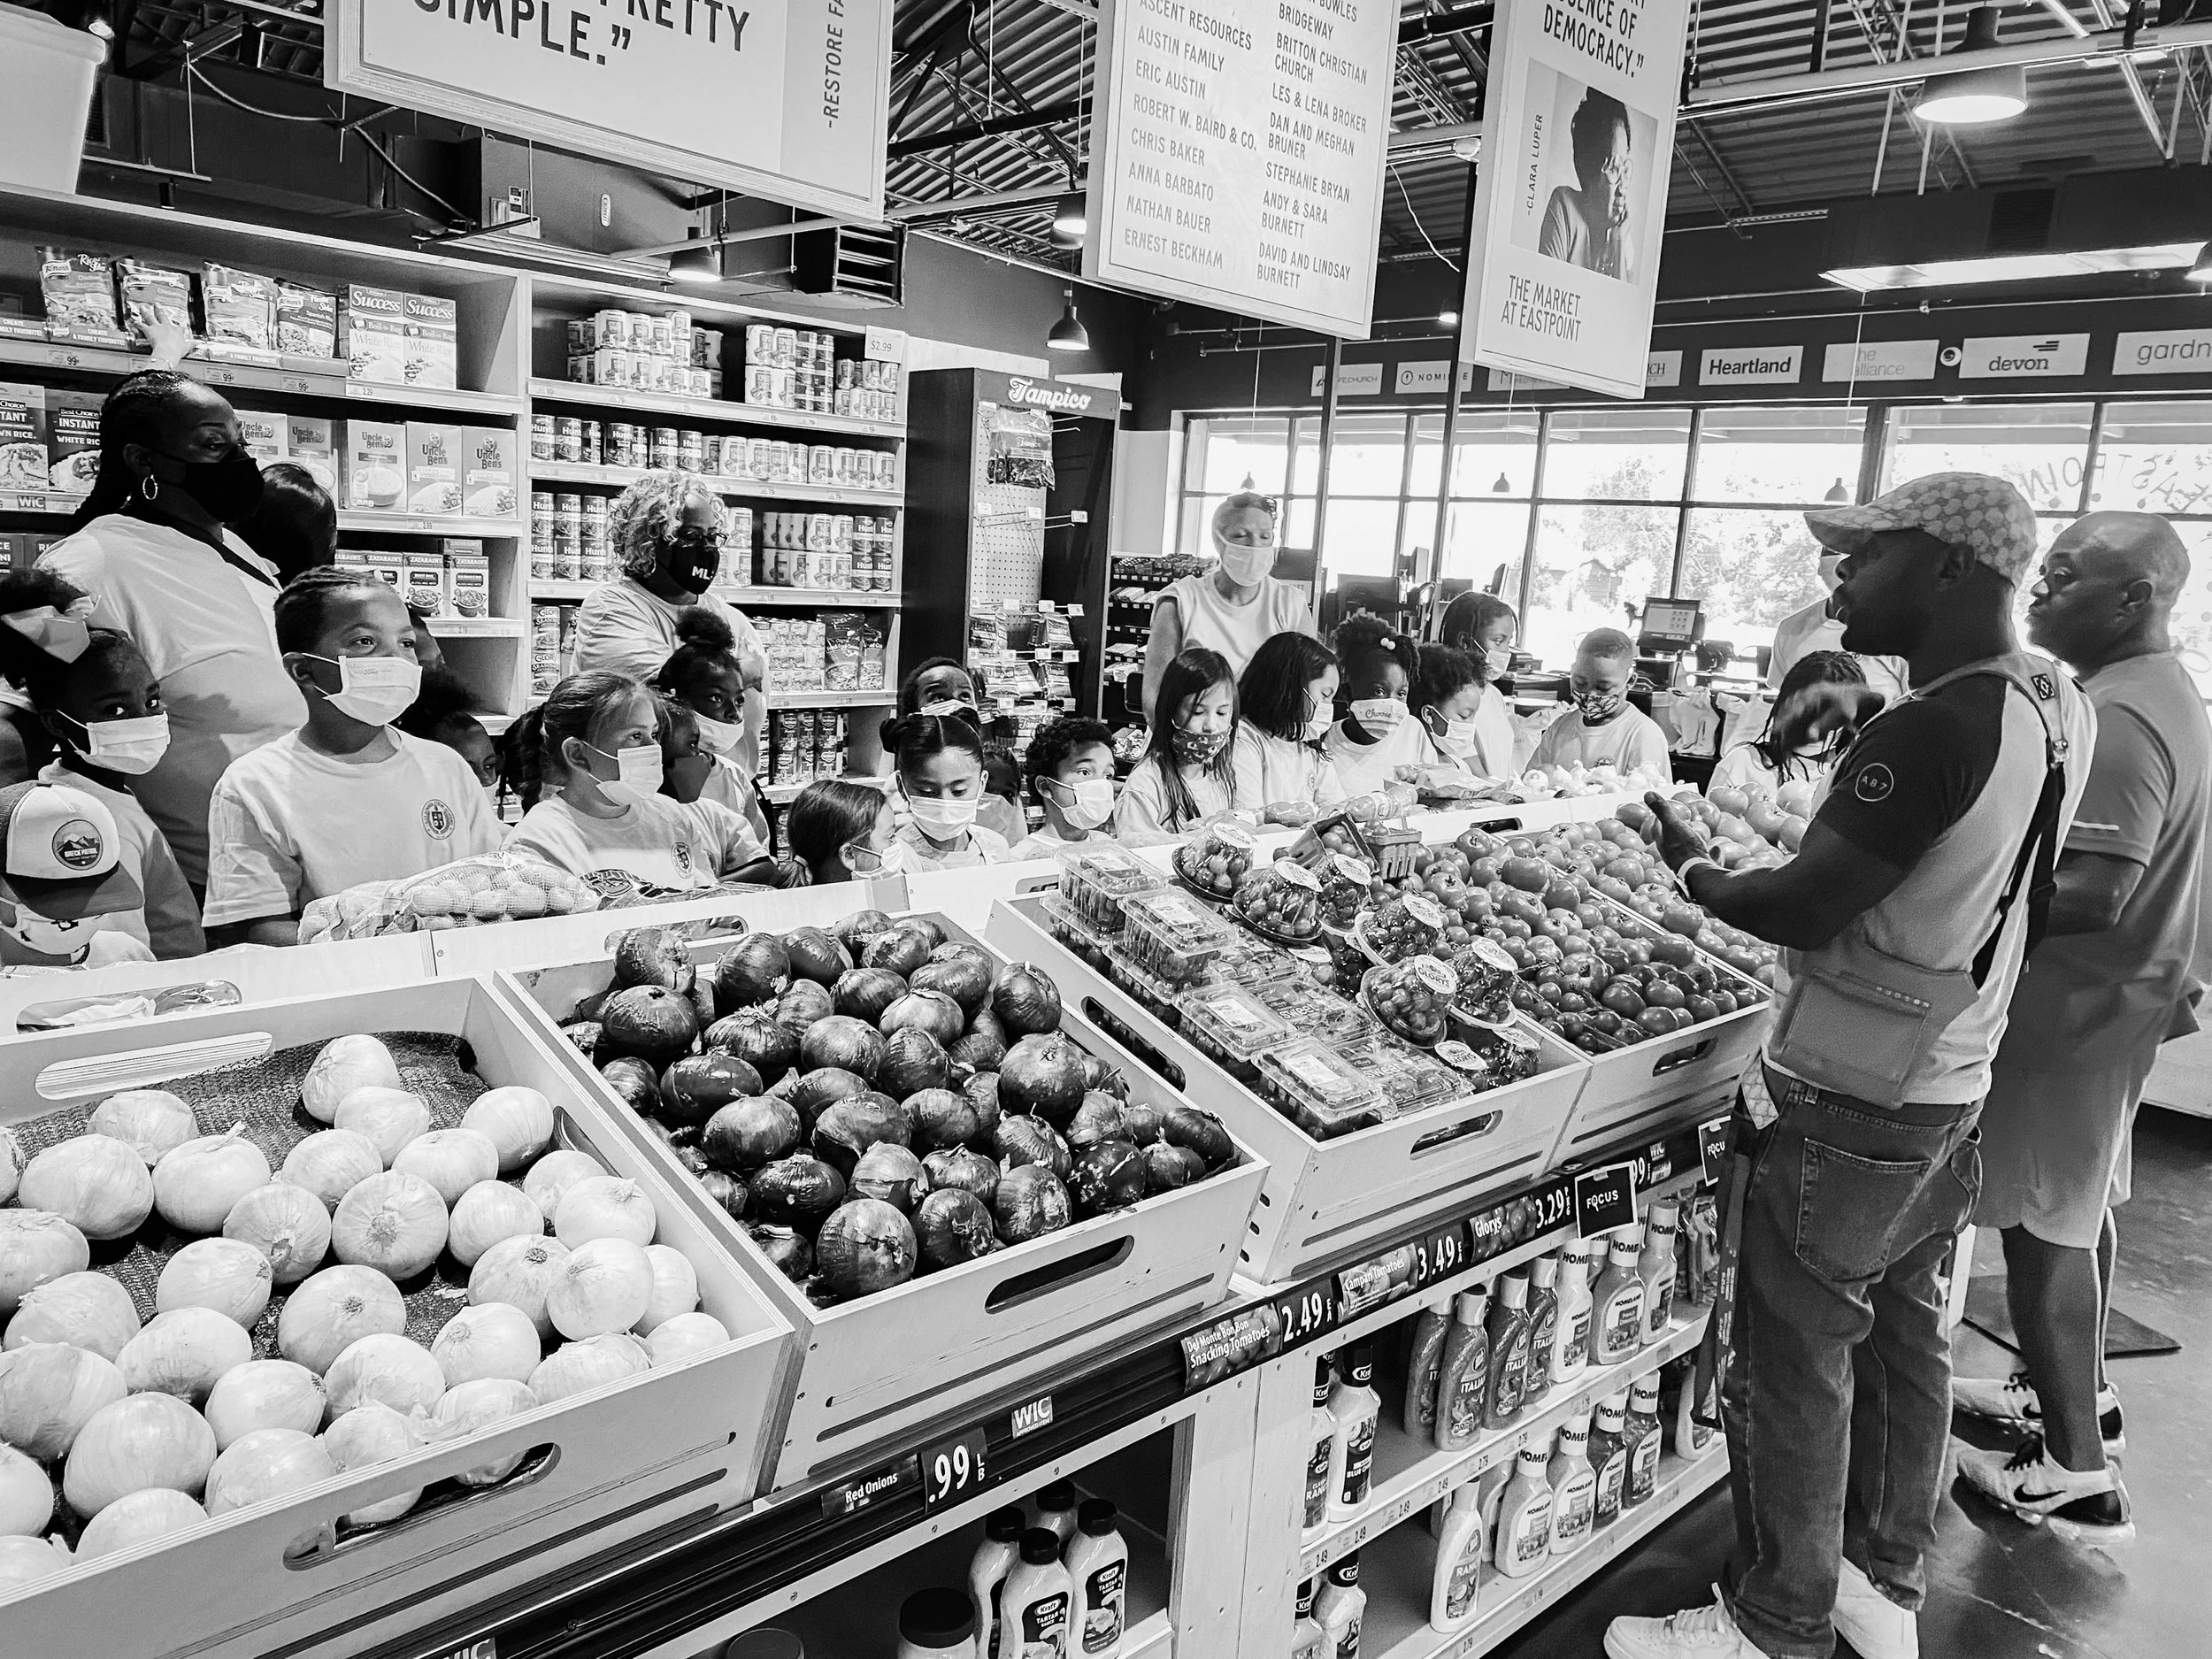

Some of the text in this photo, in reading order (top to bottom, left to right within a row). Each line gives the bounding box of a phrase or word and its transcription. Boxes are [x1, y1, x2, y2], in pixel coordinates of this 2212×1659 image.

[413, 0, 631, 65] MPLE.”
[599, 0, 749, 52] ETTY
[1189, 10, 1252, 50] RESOURCES
[1279, 3, 1333, 41] BRIDGEWAY
[1619, 8, 1637, 39] OF
[1138, 25, 1225, 73] AUSTIN FAMILY
[1277, 32, 1367, 85] BRITTON CHRISTIAN
[1136, 59, 1206, 100] ERIC AUSTIN
[1275, 54, 1314, 83] CHURCH
[1272, 82, 1367, 134] LES & LENA BROKER
[1133, 94, 1256, 151] ROBERT W. BAIRD & CO.
[1270, 111, 1355, 157] DAN AND MEGHAN
[1532, 114, 1543, 157] LUPER
[1132, 127, 1205, 166] CHRIS BAKER
[1268, 133, 1306, 160] BRUNER
[1128, 162, 1214, 202] ANNA BARBATO
[1265, 161, 1350, 204] STEPHANIE BRYAN
[1126, 195, 1210, 234] NATHAN BAUER
[1263, 190, 1328, 224] ANDY & SARA
[1262, 212, 1304, 239] BURNETT
[1125, 228, 1223, 269] ERNEST BECKHAM
[1259, 242, 1351, 281] DAVID AND LINDSAY
[1256, 264, 1301, 289] BURNETT
[352, 290, 401, 312] Success
[406, 299, 453, 319] Success
[1509, 274, 1581, 318] THE MARKET
[1501, 300, 1581, 342] AT EASTPOINT
[355, 333, 384, 346] White
[410, 340, 434, 352] White
[871, 340, 892, 352] $2.99
[1418, 373, 1468, 381] NOMIE
[1709, 357, 1792, 376] Heartland
[1988, 357, 2049, 371] devon
[1008, 377, 1092, 411] Tampico
[58, 418, 101, 430] INSTANT
[362, 432, 382, 442] Uncle
[57, 435, 101, 446] WHITE RIC
[422, 444, 447, 457] Uncle
[476, 448, 500, 461] Uncle
[692, 566, 715, 580] ML
[1707, 1141, 1725, 1159] FOCU
[1474, 1188, 1564, 1239] Glorys 3.29
[1586, 1189, 1619, 1212] FOCUS
[1343, 1235, 1455, 1292] Campari Tomatoes 3.49
[1187, 1320, 1249, 1352] Del Monte Bon Bon
[1190, 1292, 1323, 1368] Snacking Tomatoes 2.49
[1533, 1333, 1555, 1350] ITALI
[1506, 1356, 1528, 1372] ITALI
[1014, 1396, 1050, 1430] WIC
[845, 1486, 864, 1503] Red
[865, 1472, 898, 1497] Onions
[928, 1444, 971, 1503] .99
[1438, 1478, 1448, 1494] 2.49
[1306, 1486, 1327, 1501] RANC
[1398, 1500, 1410, 1518] 2.49
[1355, 1526, 1366, 1545] 2.49
[1316, 1549, 1328, 1568] 2.49
[1456, 1562, 1477, 1577] RAN
[1102, 1570, 1117, 1580] Kraft
[1036, 1611, 1059, 1624] TARTAR
[1040, 1602, 1056, 1613] Kraft
